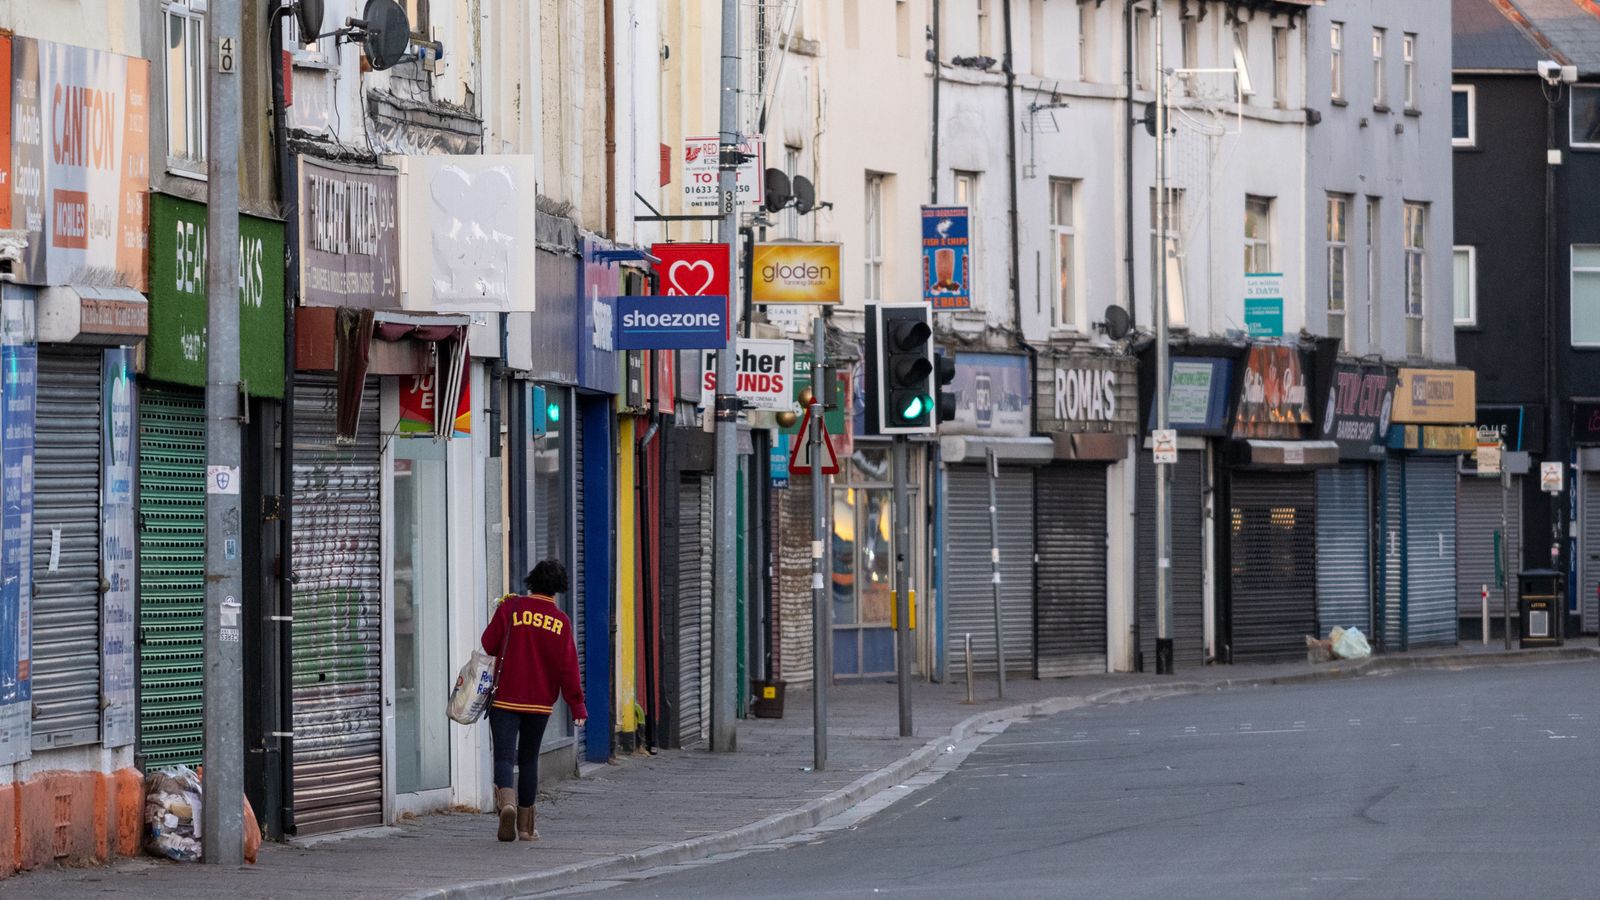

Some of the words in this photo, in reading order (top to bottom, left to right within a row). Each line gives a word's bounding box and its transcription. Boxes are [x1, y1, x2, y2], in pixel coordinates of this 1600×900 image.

[221, 38, 232, 72] 40
[15, 103, 40, 145] Mobile
[52, 82, 115, 171] CANTON
[702, 144, 718, 155] RED
[14, 153, 41, 205] Laptop
[693, 173, 712, 183] TO
[685, 186, 711, 194] 01633
[725, 190, 733, 213] 38
[56, 201, 85, 237] MOBILES
[311, 174, 348, 255] FALAFEL
[348, 180, 378, 257] WALES
[238, 235, 263, 308] AKS
[762, 261, 831, 283] gloden
[784, 279, 807, 287] Tanning
[1256, 287, 1280, 295] DAYS
[623, 310, 720, 327] shoezone
[706, 349, 785, 373] rher
[410, 374, 434, 394] JU
[704, 372, 783, 393] SUNDS
[1055, 367, 1116, 421] ROMA'S
[1336, 371, 1362, 415] TOP
[1336, 420, 1358, 439] BARBER
[1358, 422, 1375, 440] SHOP
[512, 610, 564, 635] LOSER
